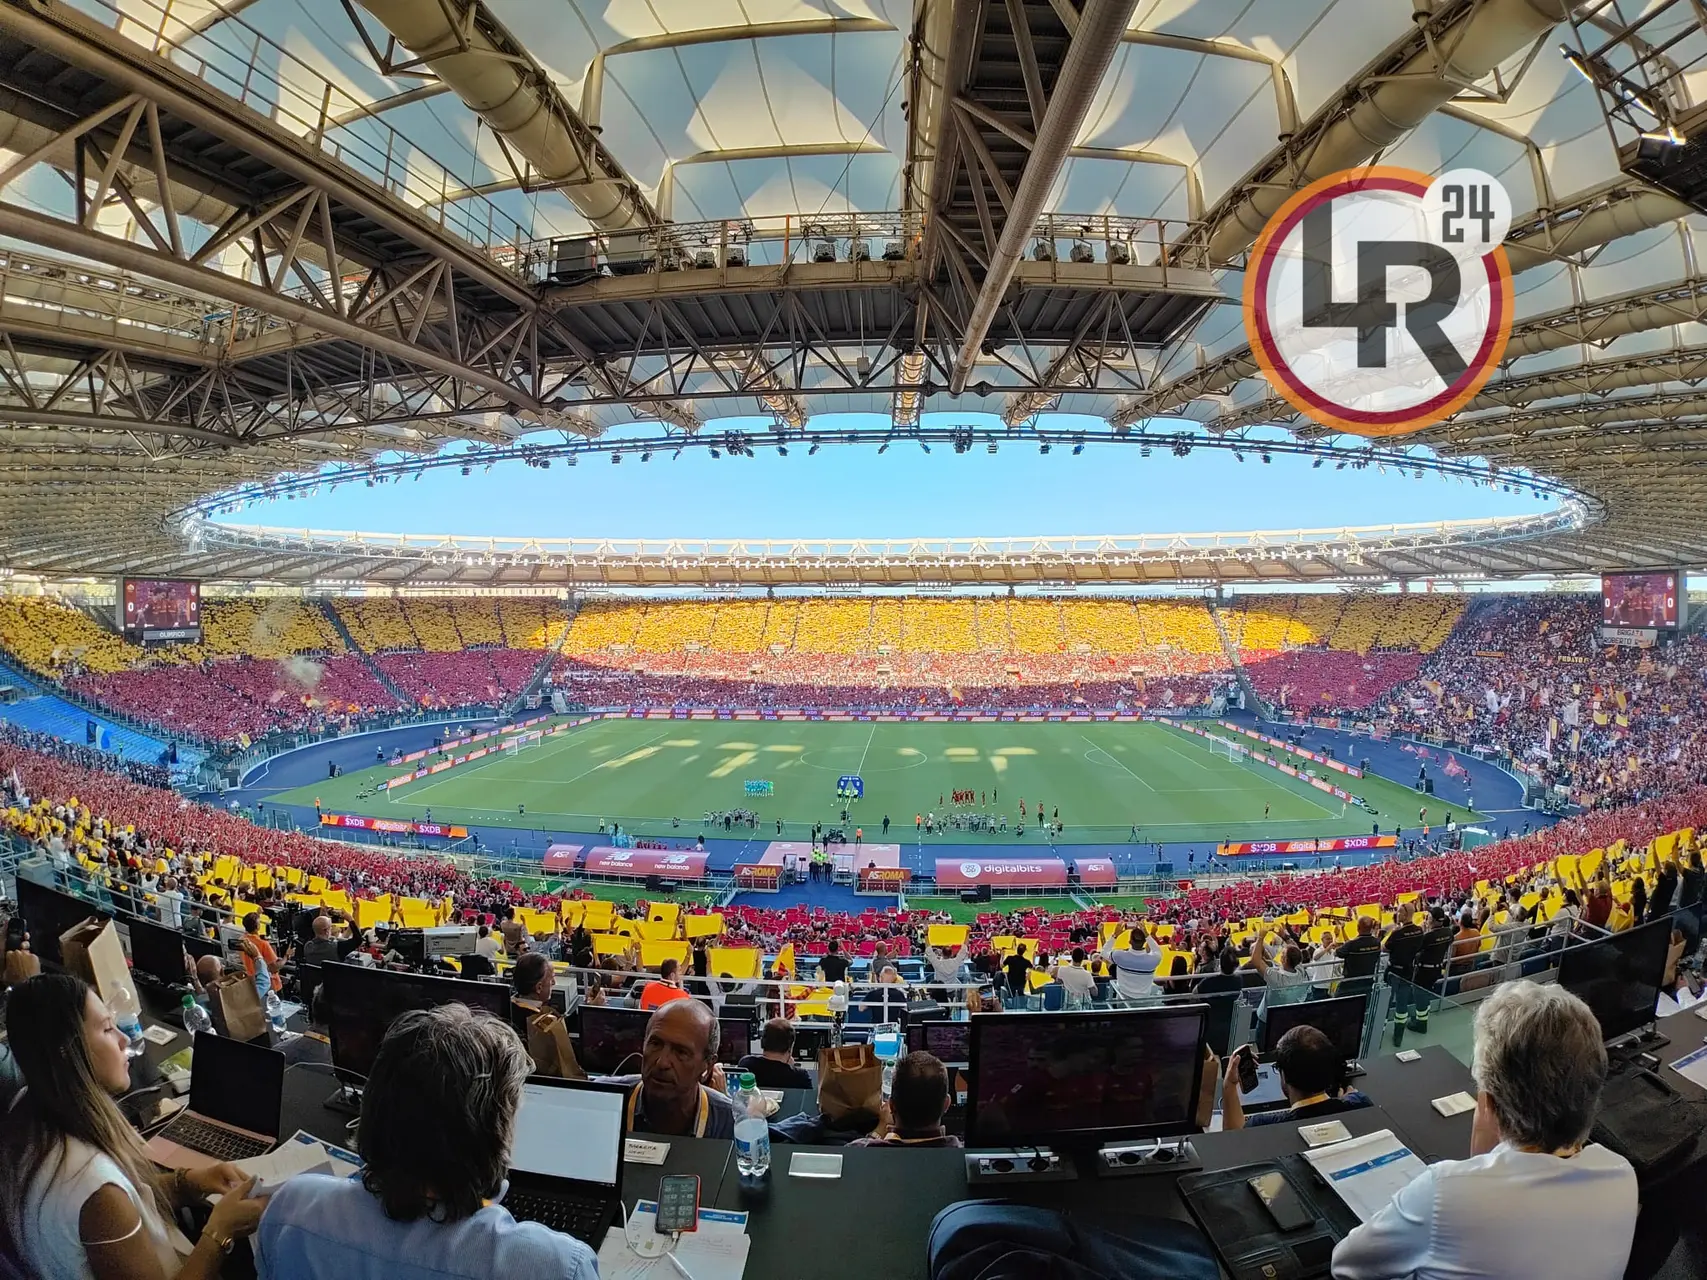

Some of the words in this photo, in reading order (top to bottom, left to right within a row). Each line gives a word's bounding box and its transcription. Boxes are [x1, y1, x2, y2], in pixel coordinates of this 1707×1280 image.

[128, 602, 134, 611] 0
[191, 602, 196, 611] 0
[1605, 598, 1610, 607] 0
[1668, 598, 1673, 608] 0
[984, 864, 1042, 874] digitalbits
